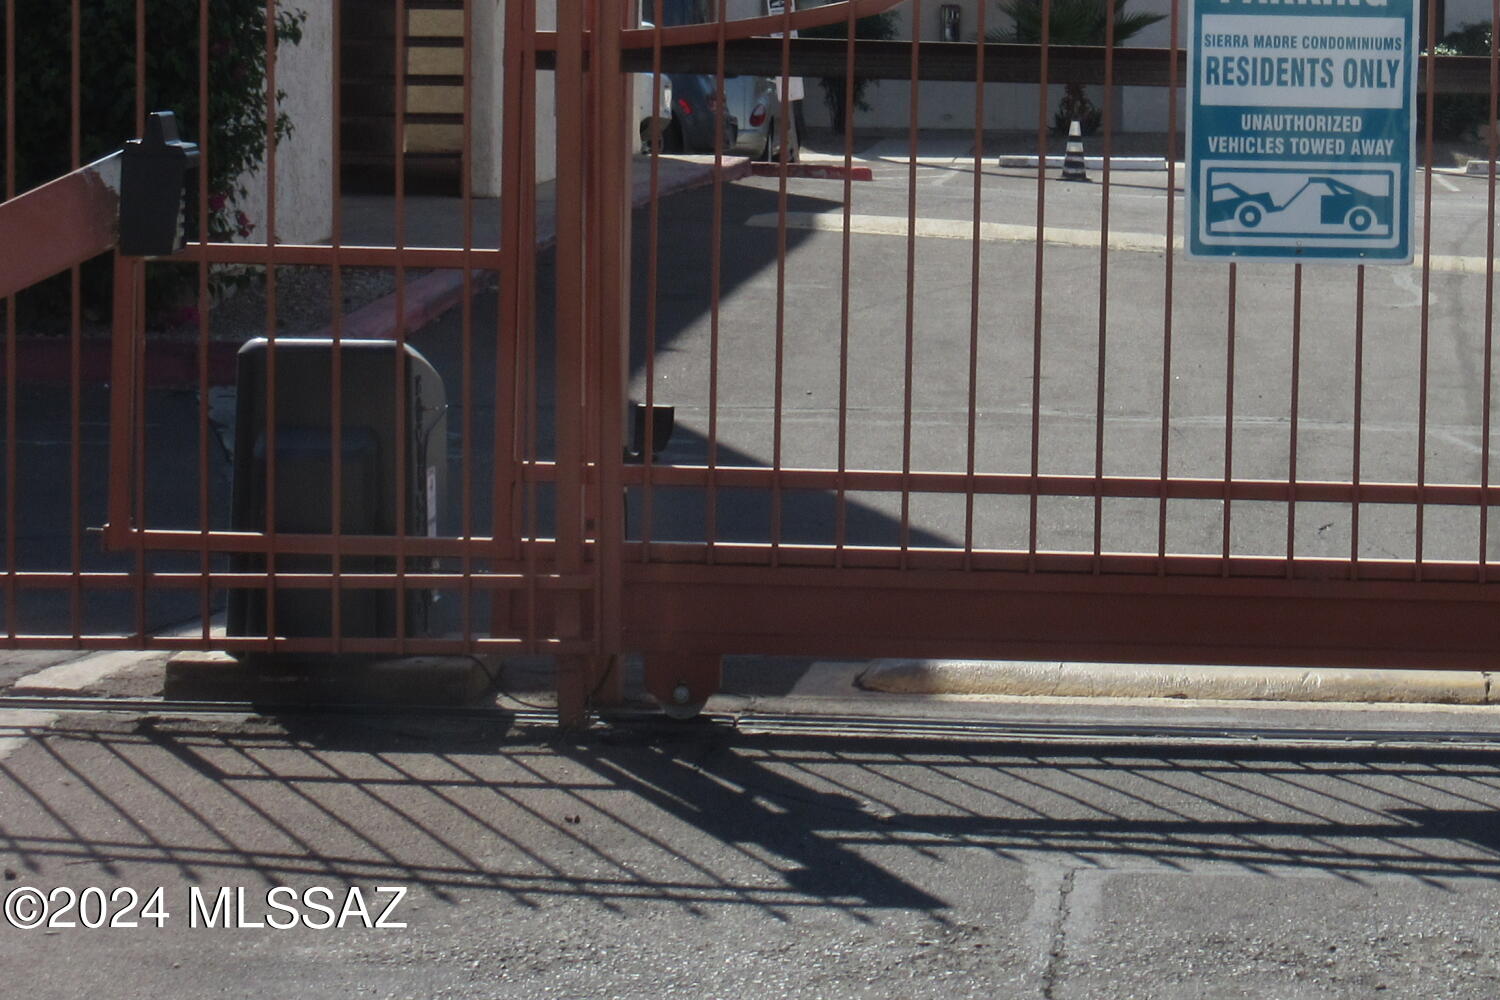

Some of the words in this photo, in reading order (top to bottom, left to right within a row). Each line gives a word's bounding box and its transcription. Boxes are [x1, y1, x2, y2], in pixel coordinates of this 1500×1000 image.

[1204, 33, 1249, 49] SIERRA
[1253, 34, 1298, 49] MADRE
[1302, 35, 1402, 51] CONDOMINIUMS
[1206, 56, 1334, 88] RESIDENTS
[1343, 58, 1400, 89] ONLY
[1241, 114, 1363, 133] UNAUTHORIZED
[1208, 136, 1285, 154] VEHICLES
[1290, 137, 1345, 156] TOWED
[1351, 138, 1394, 156] AWAY
